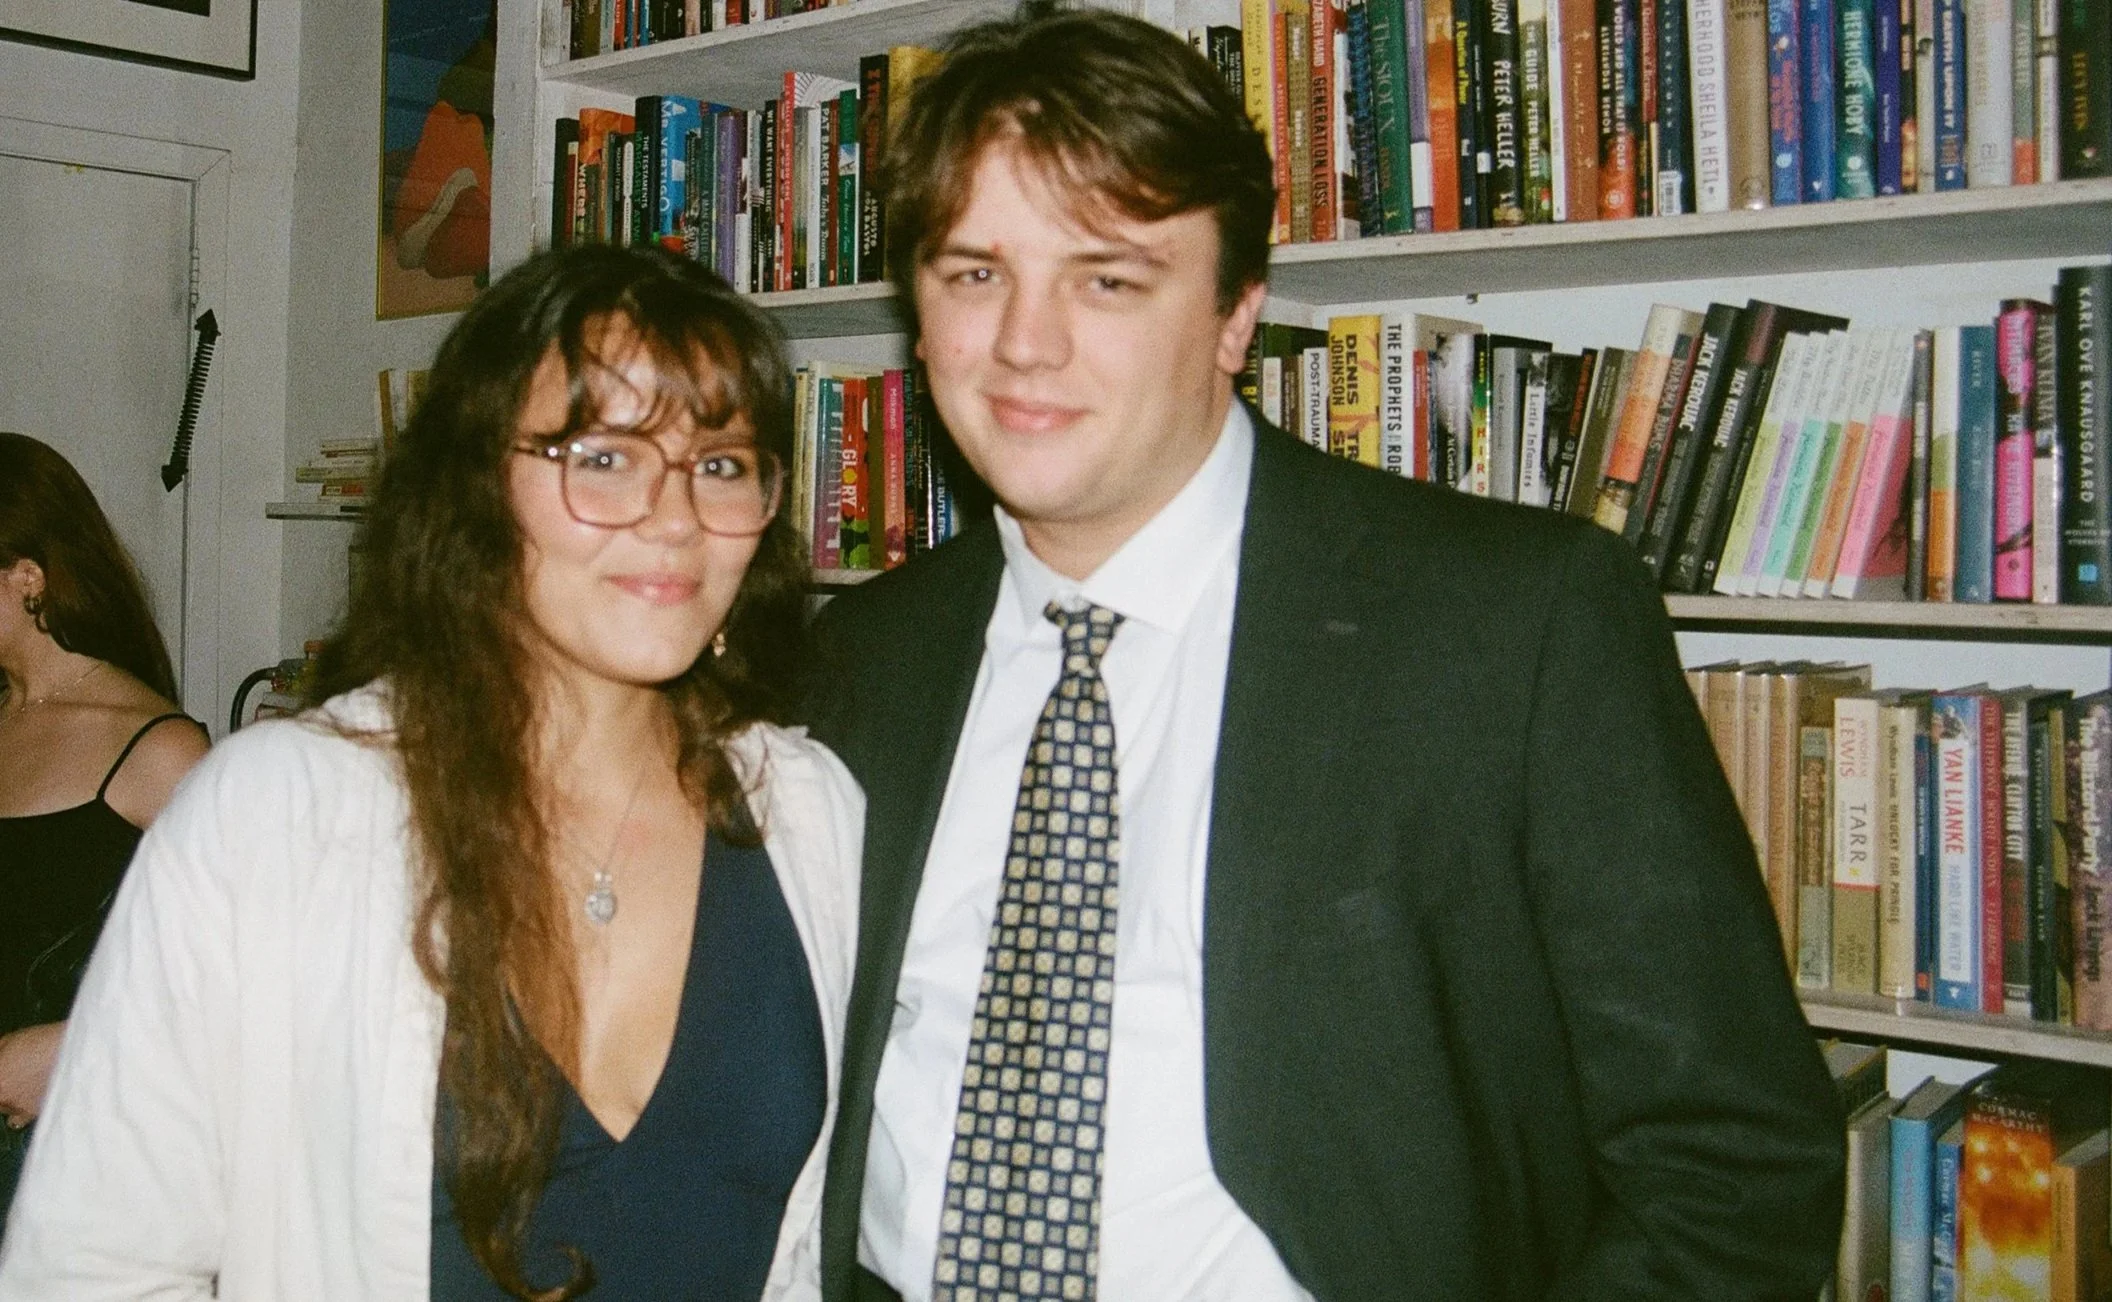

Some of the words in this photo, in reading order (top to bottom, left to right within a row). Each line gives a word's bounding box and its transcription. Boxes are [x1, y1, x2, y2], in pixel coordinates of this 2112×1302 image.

[1614, 6, 1624, 44] WORLD
[1313, 38, 1325, 66] HAND
[1525, 48, 1538, 90] GUIDE
[1615, 48, 1625, 69] AND
[1843, 10, 1862, 88] HERMIONE
[1375, 60, 1395, 133] SIOUX
[1493, 60, 1513, 106] PETER
[1615, 73, 1625, 91] ALL
[766, 110, 772, 123] WE
[820, 107, 829, 132] PAT
[1313, 77, 1328, 168] GENERATION
[1527, 100, 1539, 135] PETER
[1615, 95, 1625, 119] THAT
[1699, 82, 1718, 140] SHEILA
[1845, 94, 1863, 136] HOBY
[820, 135, 829, 185] BARKER
[1495, 112, 1515, 170] HELLER
[1528, 138, 1540, 178] HELLER
[634, 131, 642, 204] MARGARET
[660, 137, 670, 212] VERTIGO
[764, 156, 772, 212] EVERYTHING
[1701, 146, 1719, 184] HETI
[1314, 172, 1328, 208] LOSS
[2078, 287, 2093, 331] KARL
[1387, 324, 1402, 349] THE
[1695, 332, 1720, 368] JACK
[2078, 338, 2093, 373] OVE
[1331, 335, 1344, 406] JOHNSON
[1346, 334, 1358, 405] DENIS
[1727, 366, 1748, 397] JACK
[1387, 356, 1402, 431] PROPHETS
[1677, 367, 1709, 432] KEROUAC
[1712, 396, 1739, 449] KEROUAC
[2079, 380, 2094, 503] KNAUSGAARD
[842, 449, 858, 508] GLORY
[938, 486, 946, 533] BUTLER
[1839, 716, 1856, 778] LEWIS
[2080, 716, 2097, 746] The
[1943, 748, 1963, 782] YAN
[2080, 748, 2098, 823] Blizzard
[1849, 803, 1868, 863] TARR
[1944, 789, 1965, 854] LIANKE
[2077, 829, 2100, 876] Party
[1979, 1101, 2037, 1120] CORMAC
